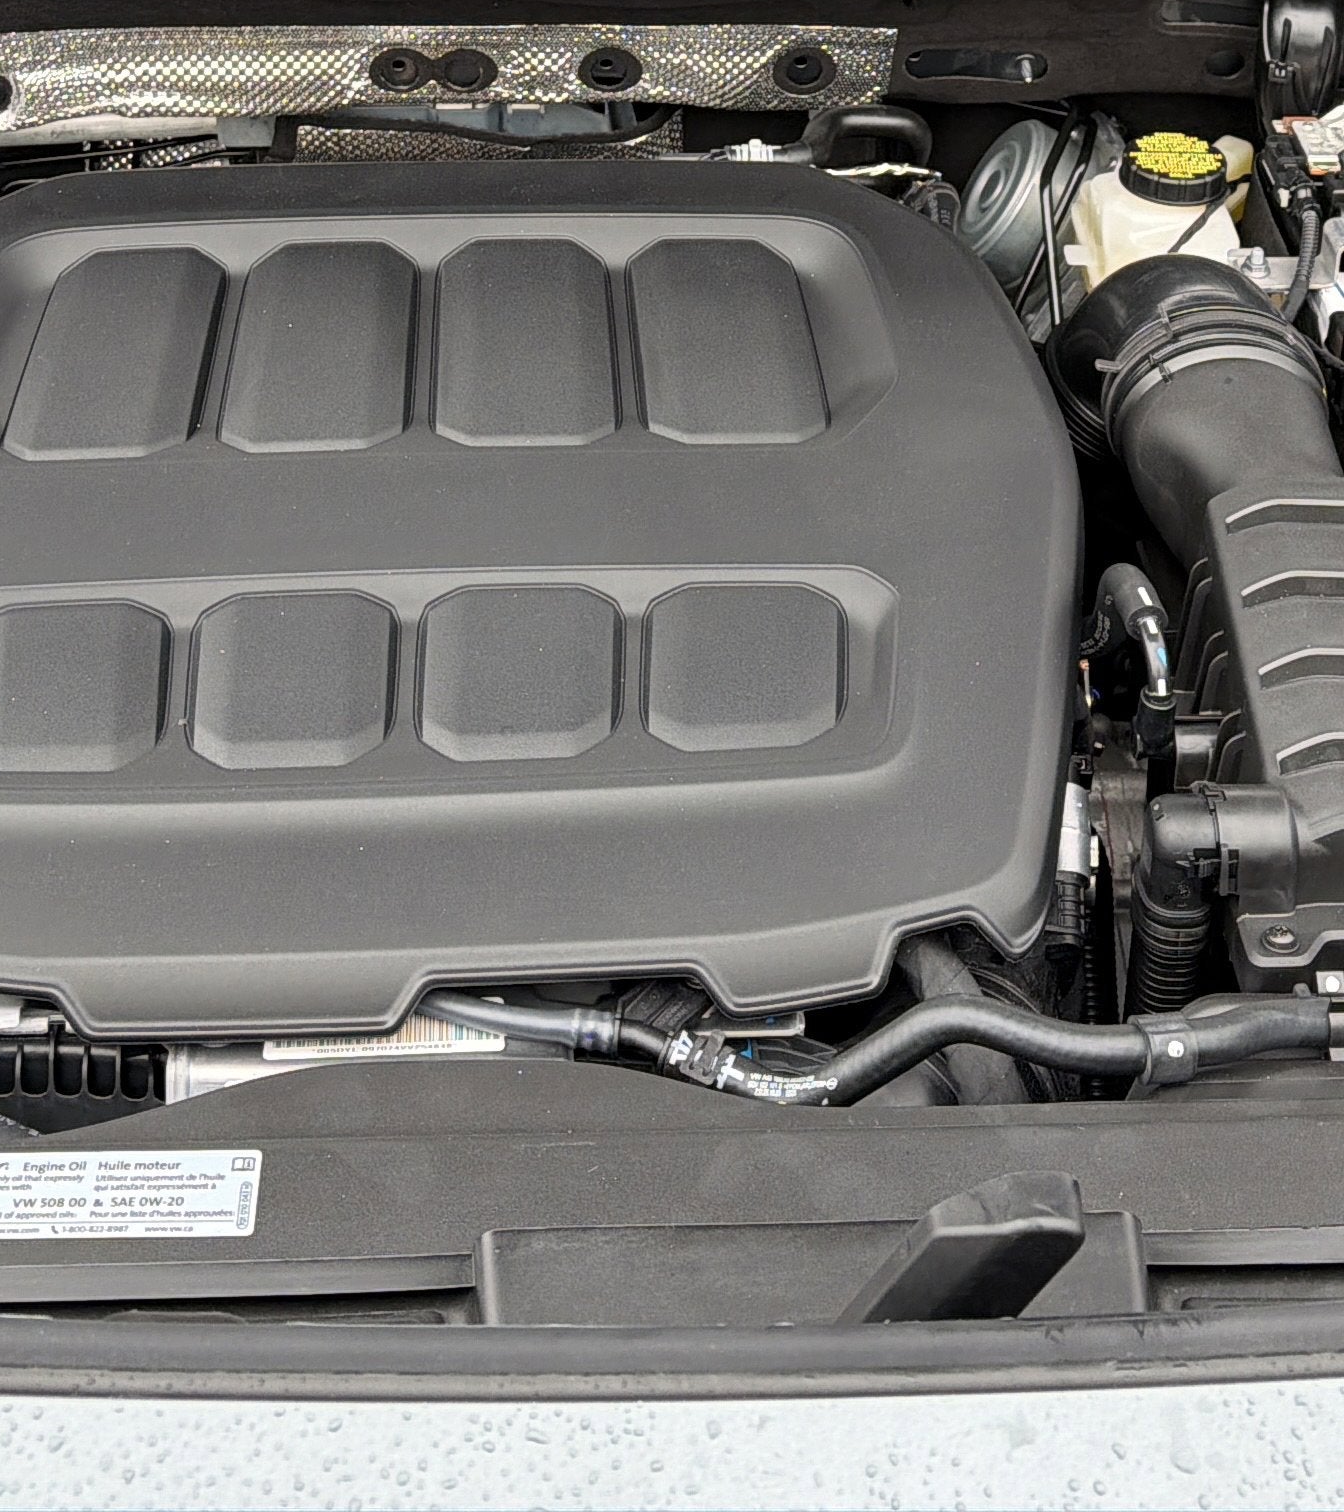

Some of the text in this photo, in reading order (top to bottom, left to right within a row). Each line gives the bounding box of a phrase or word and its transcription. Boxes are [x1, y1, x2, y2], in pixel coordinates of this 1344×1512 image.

[23, 1161, 87, 1174] Engine Oil
[98, 1161, 182, 1171] Huile moteur
[24, 1174, 42, 1182] that
[43, 1174, 85, 1184] expressly
[130, 1174, 184, 1184] uniquement
[185, 1173, 197, 1181] de
[12, 1196, 185, 1208] VW 508 00 & SAE 0W-20
[15, 1211, 57, 1220] approved
[89, 1210, 110, 1218] Pour
[111, 1210, 128, 1218] une
